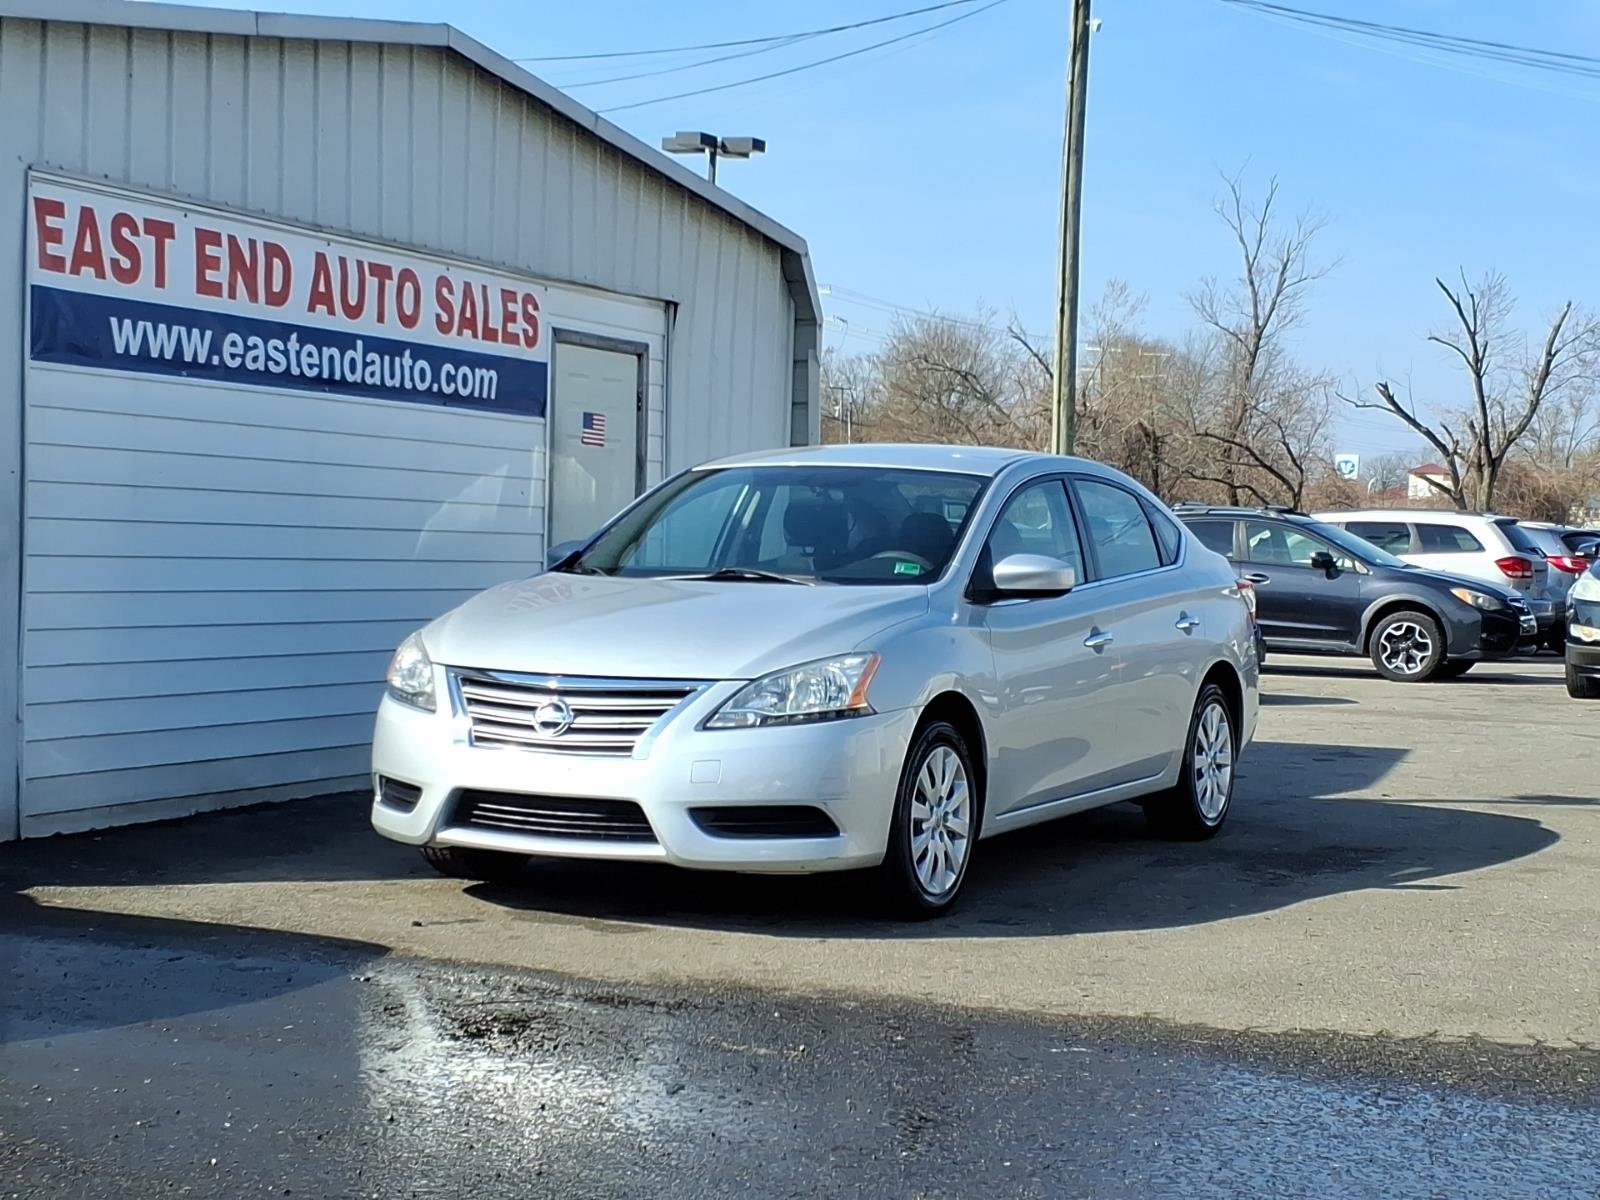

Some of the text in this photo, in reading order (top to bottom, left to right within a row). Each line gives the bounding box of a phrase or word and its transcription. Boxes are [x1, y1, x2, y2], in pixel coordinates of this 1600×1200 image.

[33, 196, 540, 350] EAST END AUTO SALES
[110, 317, 498, 400] www.eastendauto.com
